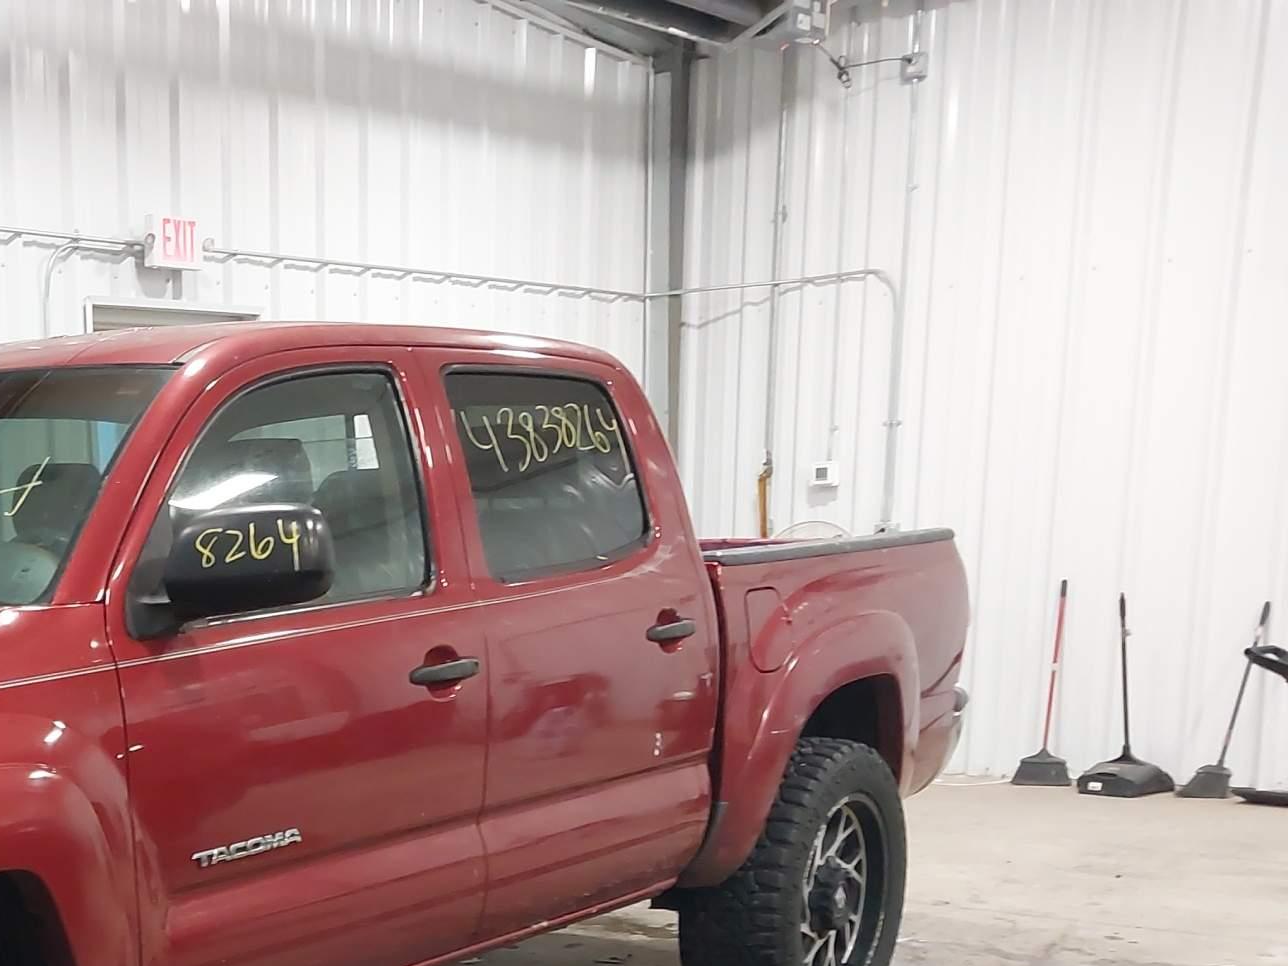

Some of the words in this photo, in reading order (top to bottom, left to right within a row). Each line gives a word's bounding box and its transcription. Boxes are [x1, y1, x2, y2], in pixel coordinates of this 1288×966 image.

[162, 217, 196, 263] EXIT
[460, 403, 633, 477] 43838264
[195, 518, 301, 571] 8264
[191, 828, 302, 867] TACOMA
